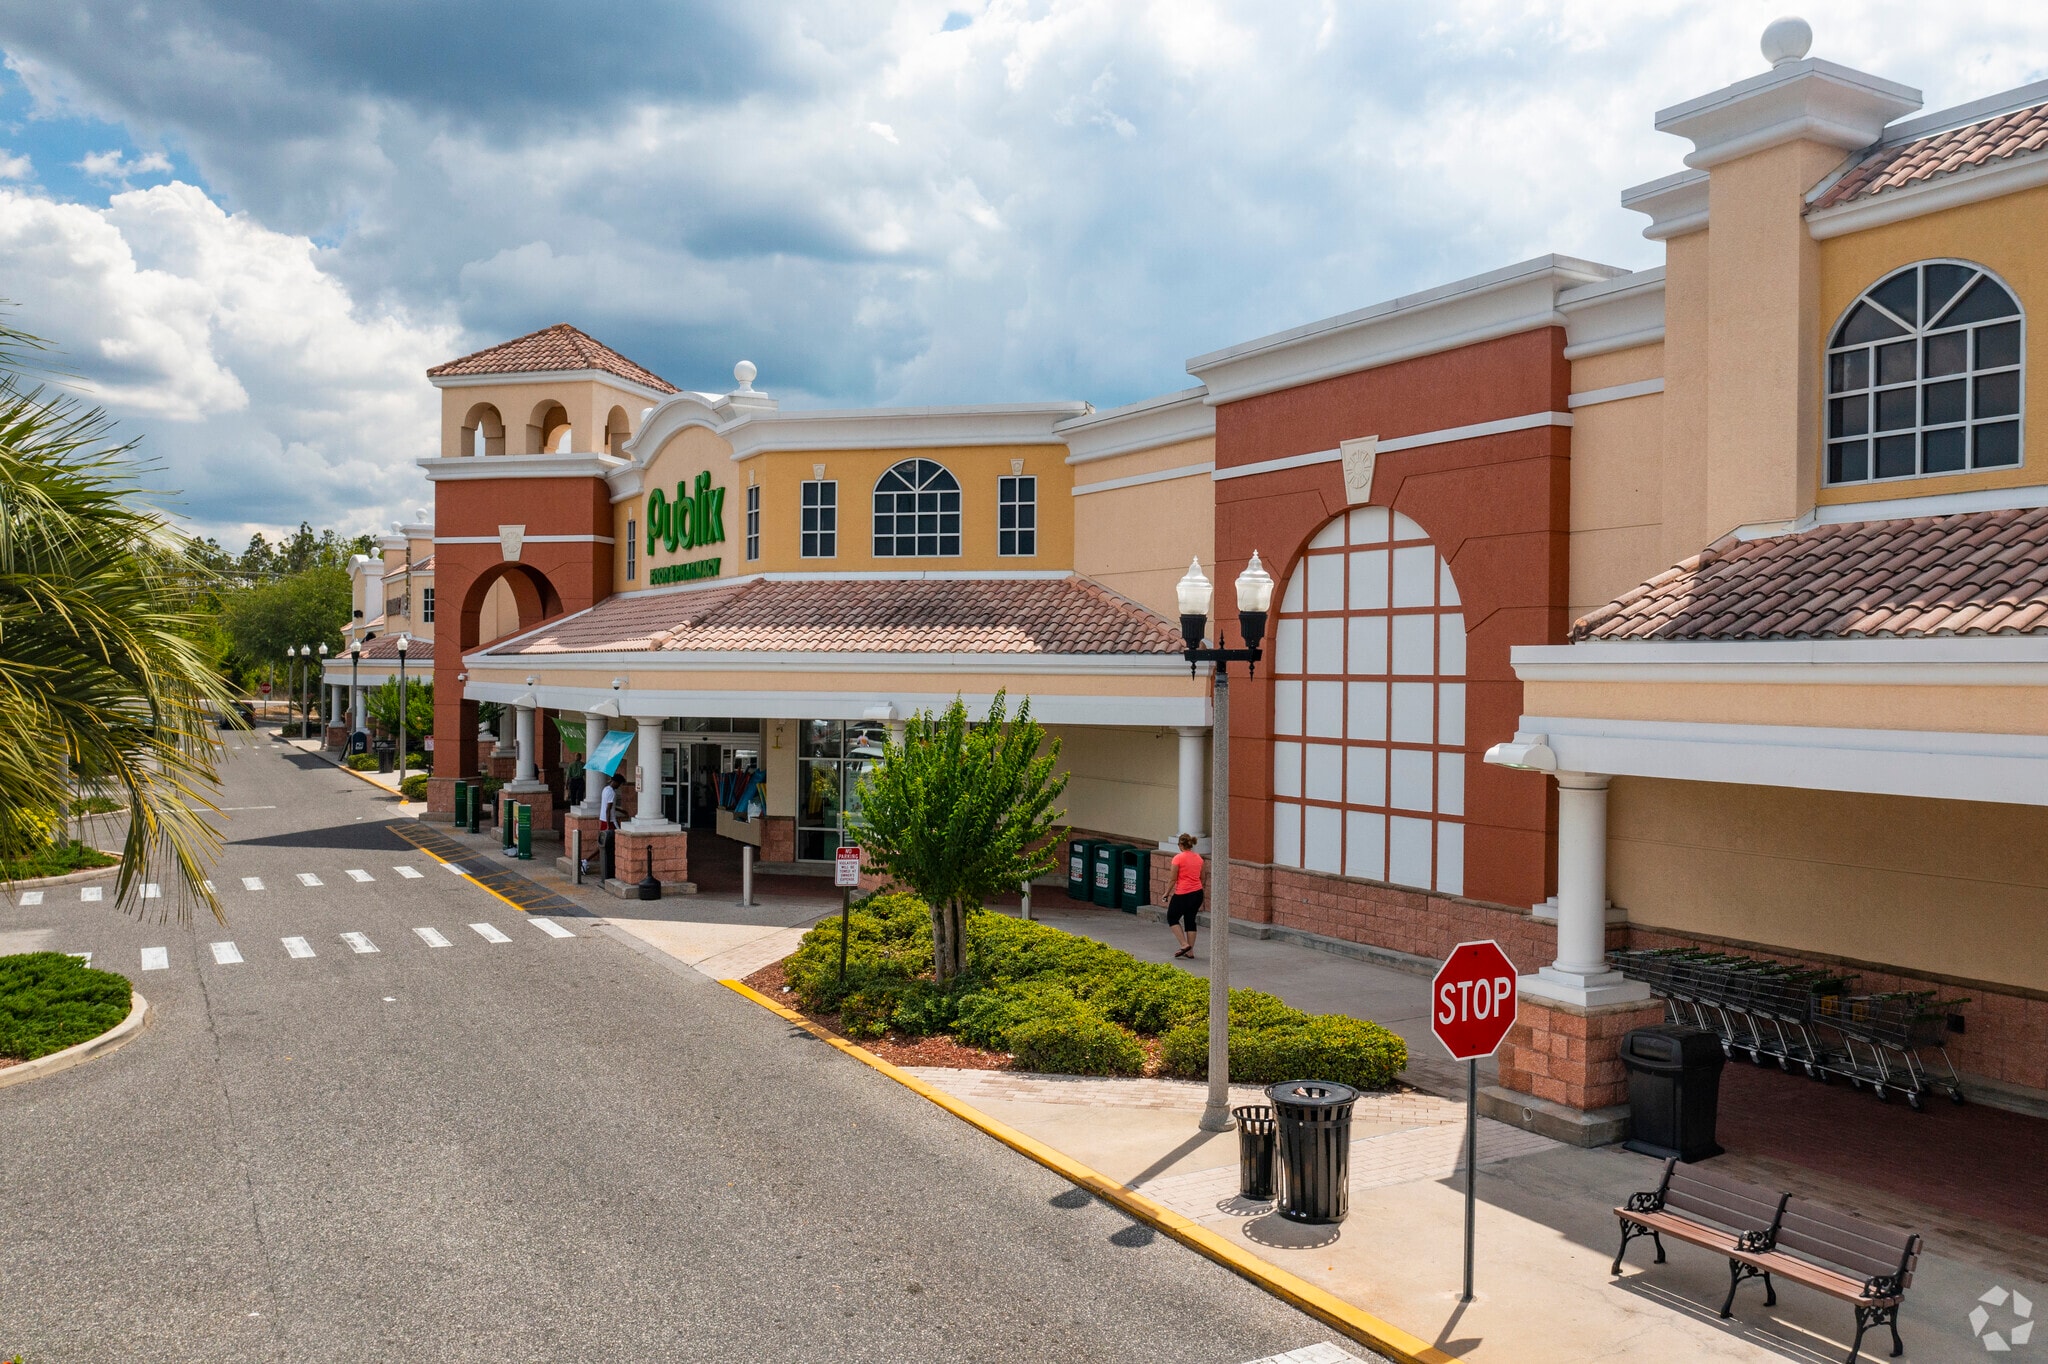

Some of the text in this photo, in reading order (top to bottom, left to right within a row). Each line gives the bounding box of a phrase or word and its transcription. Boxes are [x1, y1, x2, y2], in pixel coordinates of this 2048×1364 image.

[647, 471, 725, 555] Publix
[650, 567, 669, 585] FOOD
[675, 558, 721, 580] PHARMACY
[1438, 976, 1512, 1025] STOP
